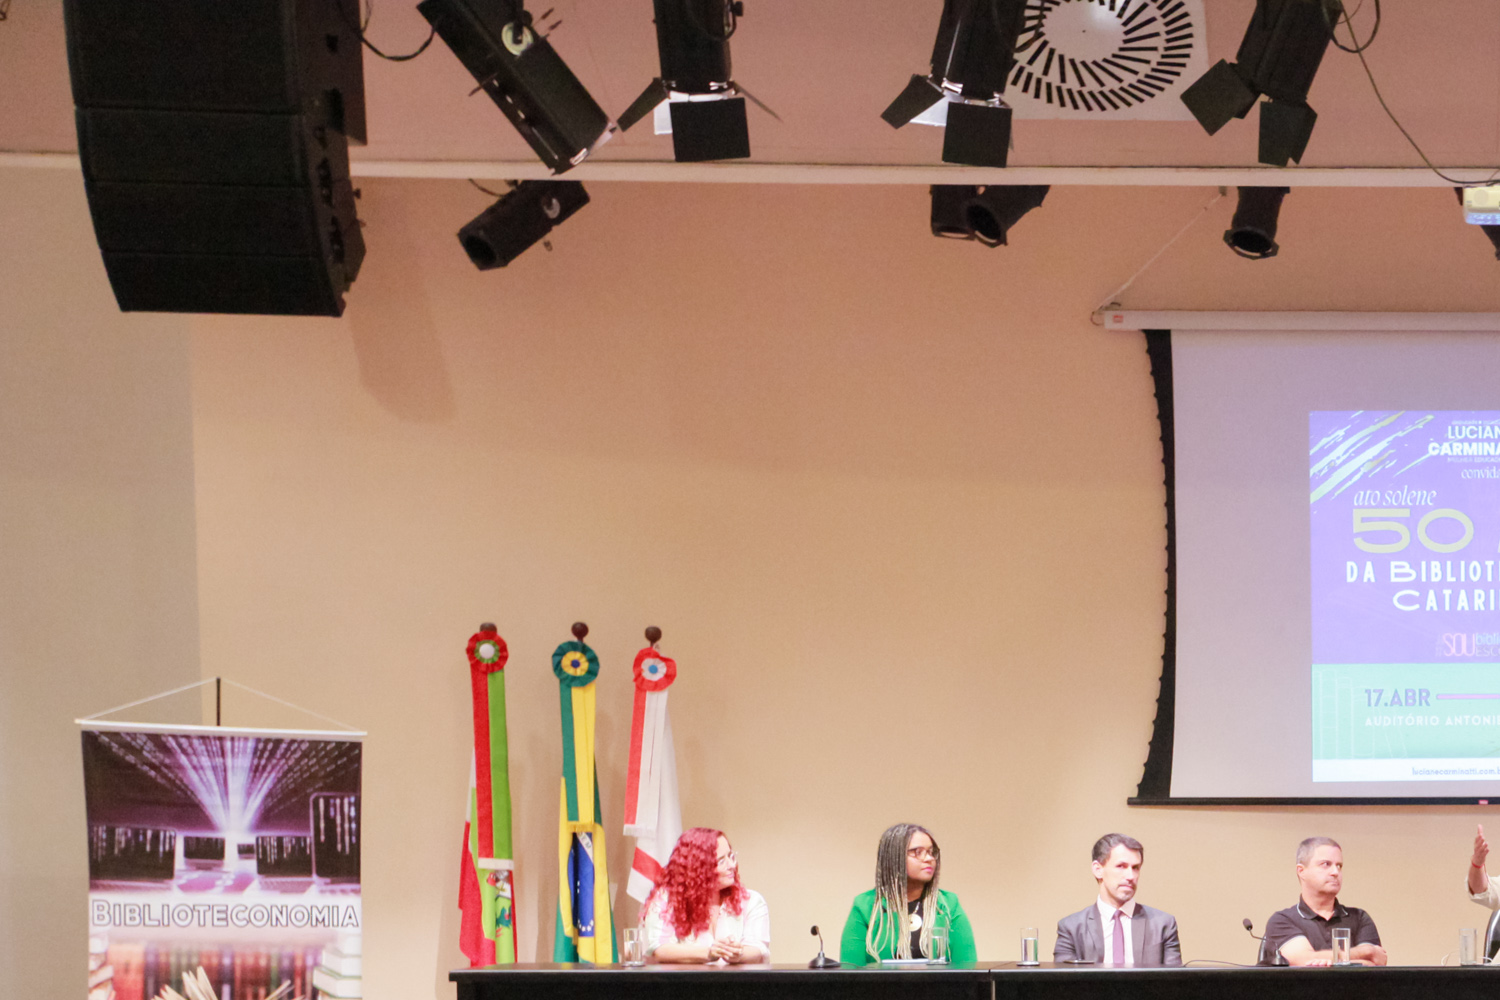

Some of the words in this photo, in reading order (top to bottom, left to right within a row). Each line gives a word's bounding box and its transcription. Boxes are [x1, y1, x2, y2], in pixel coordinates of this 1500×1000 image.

[1354, 489, 1379, 506] ato
[1383, 486, 1437, 506] solene
[1353, 508, 1474, 553] 50
[1346, 561, 1375, 583] DA
[1365, 687, 1431, 708] 17.ABR
[1365, 712, 1440, 727] AUDITÓRIO
[91, 899, 360, 928] BIBLIOTECONOMIA
